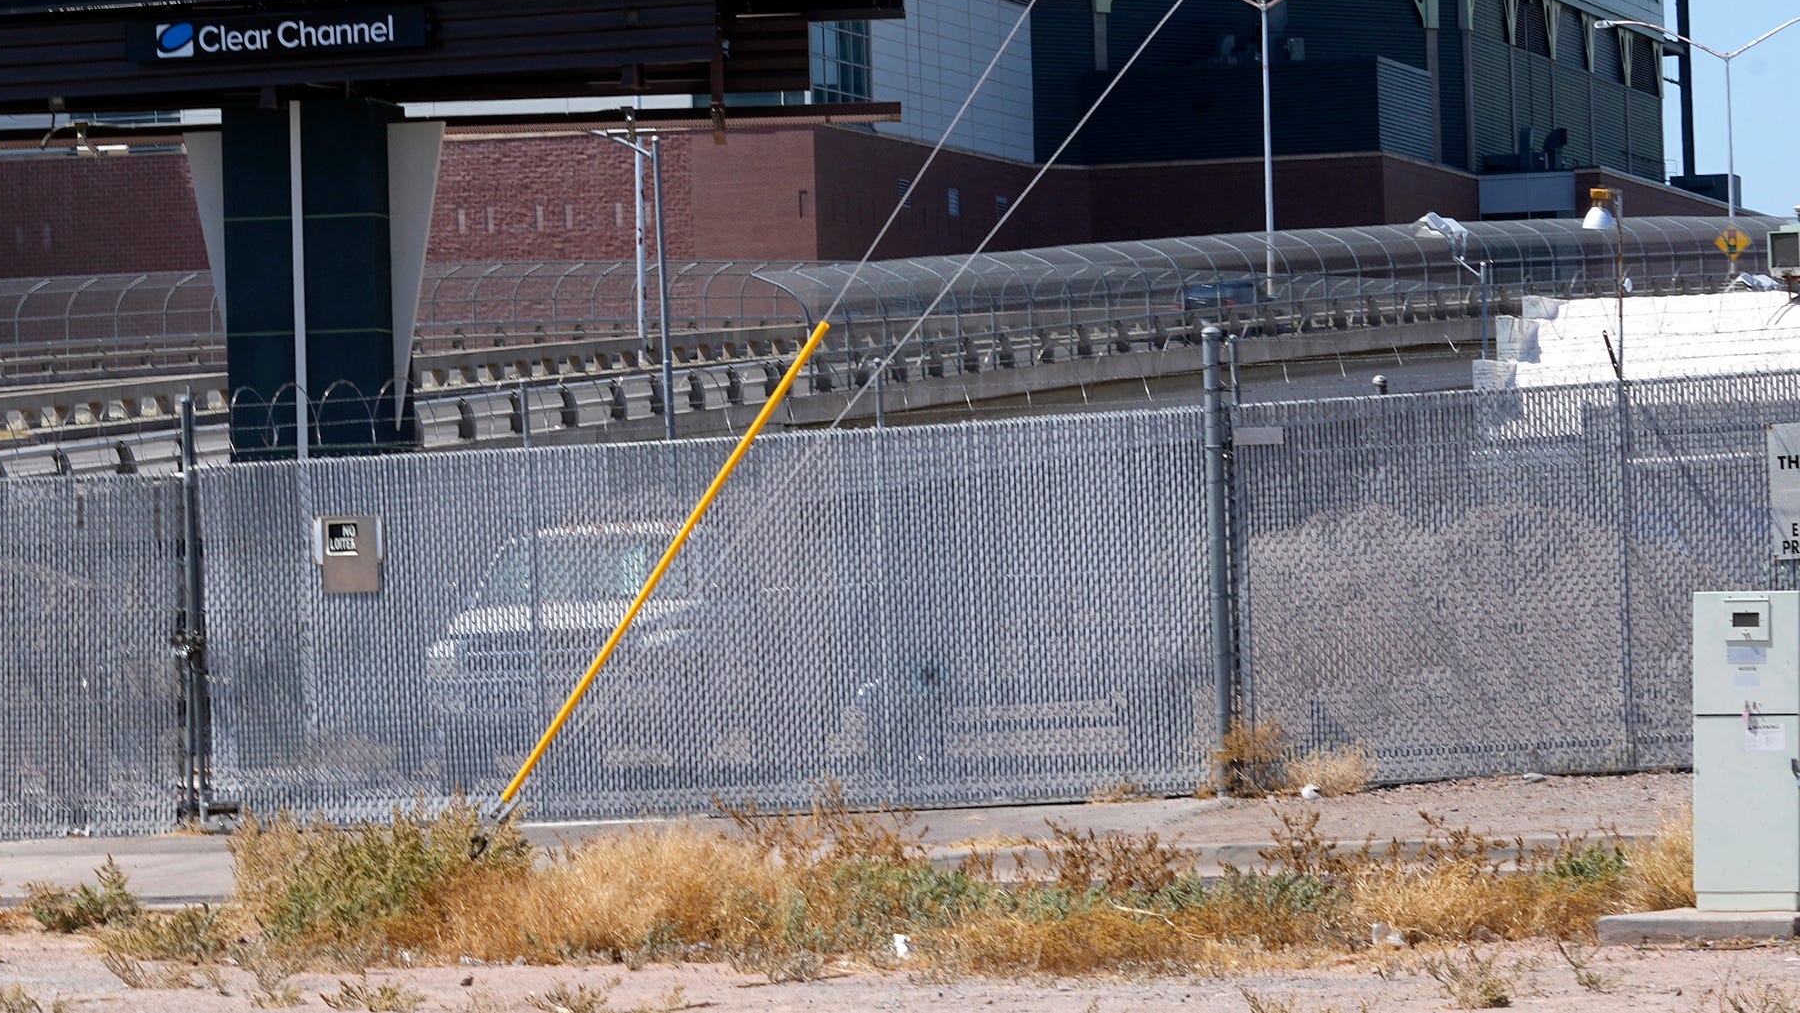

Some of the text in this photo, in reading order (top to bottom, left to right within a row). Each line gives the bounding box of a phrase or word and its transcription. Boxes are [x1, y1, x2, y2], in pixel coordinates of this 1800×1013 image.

[198, 14, 394, 52] Clear Channel
[342, 525, 356, 537] NO
